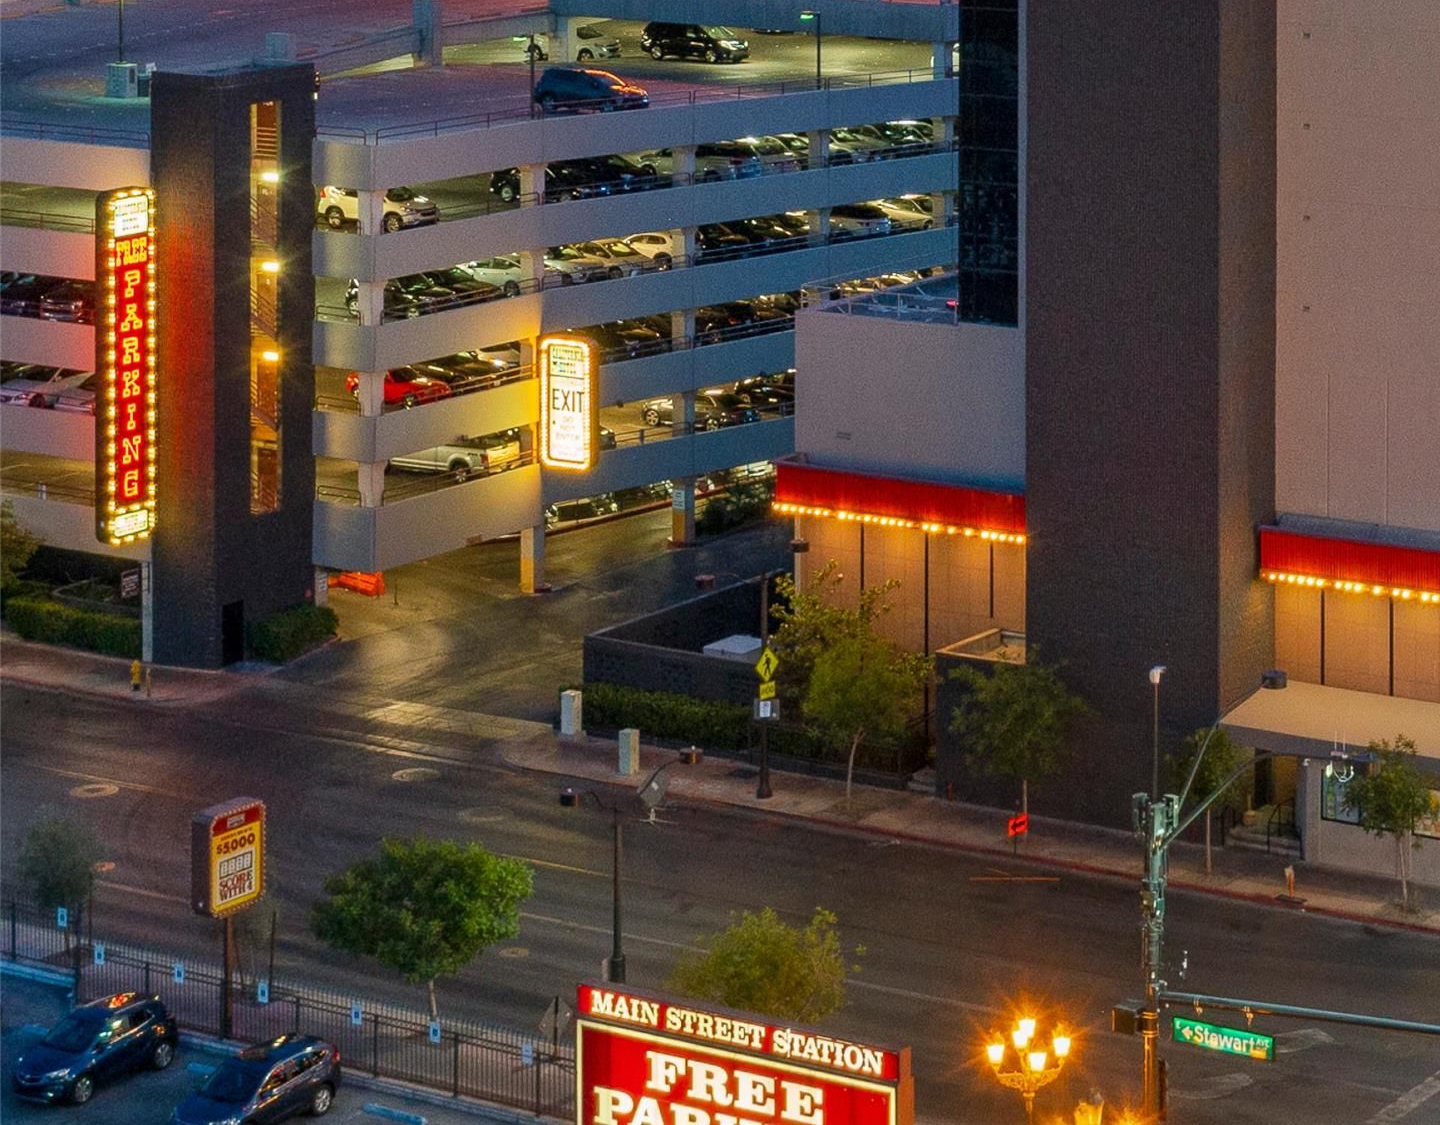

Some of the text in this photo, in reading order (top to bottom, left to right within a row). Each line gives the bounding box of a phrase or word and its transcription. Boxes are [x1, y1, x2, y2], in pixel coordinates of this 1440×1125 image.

[115, 236, 148, 267] FREE
[120, 269, 143, 498] PARKING
[552, 388, 585, 413] EXIT
[220, 870, 254, 890] SCORE
[220, 879, 246, 901] WITH
[591, 990, 884, 1075] MAIN STREET STATION
[1193, 1025, 1256, 1053] Stewart
[646, 1050, 824, 1125] FREE
